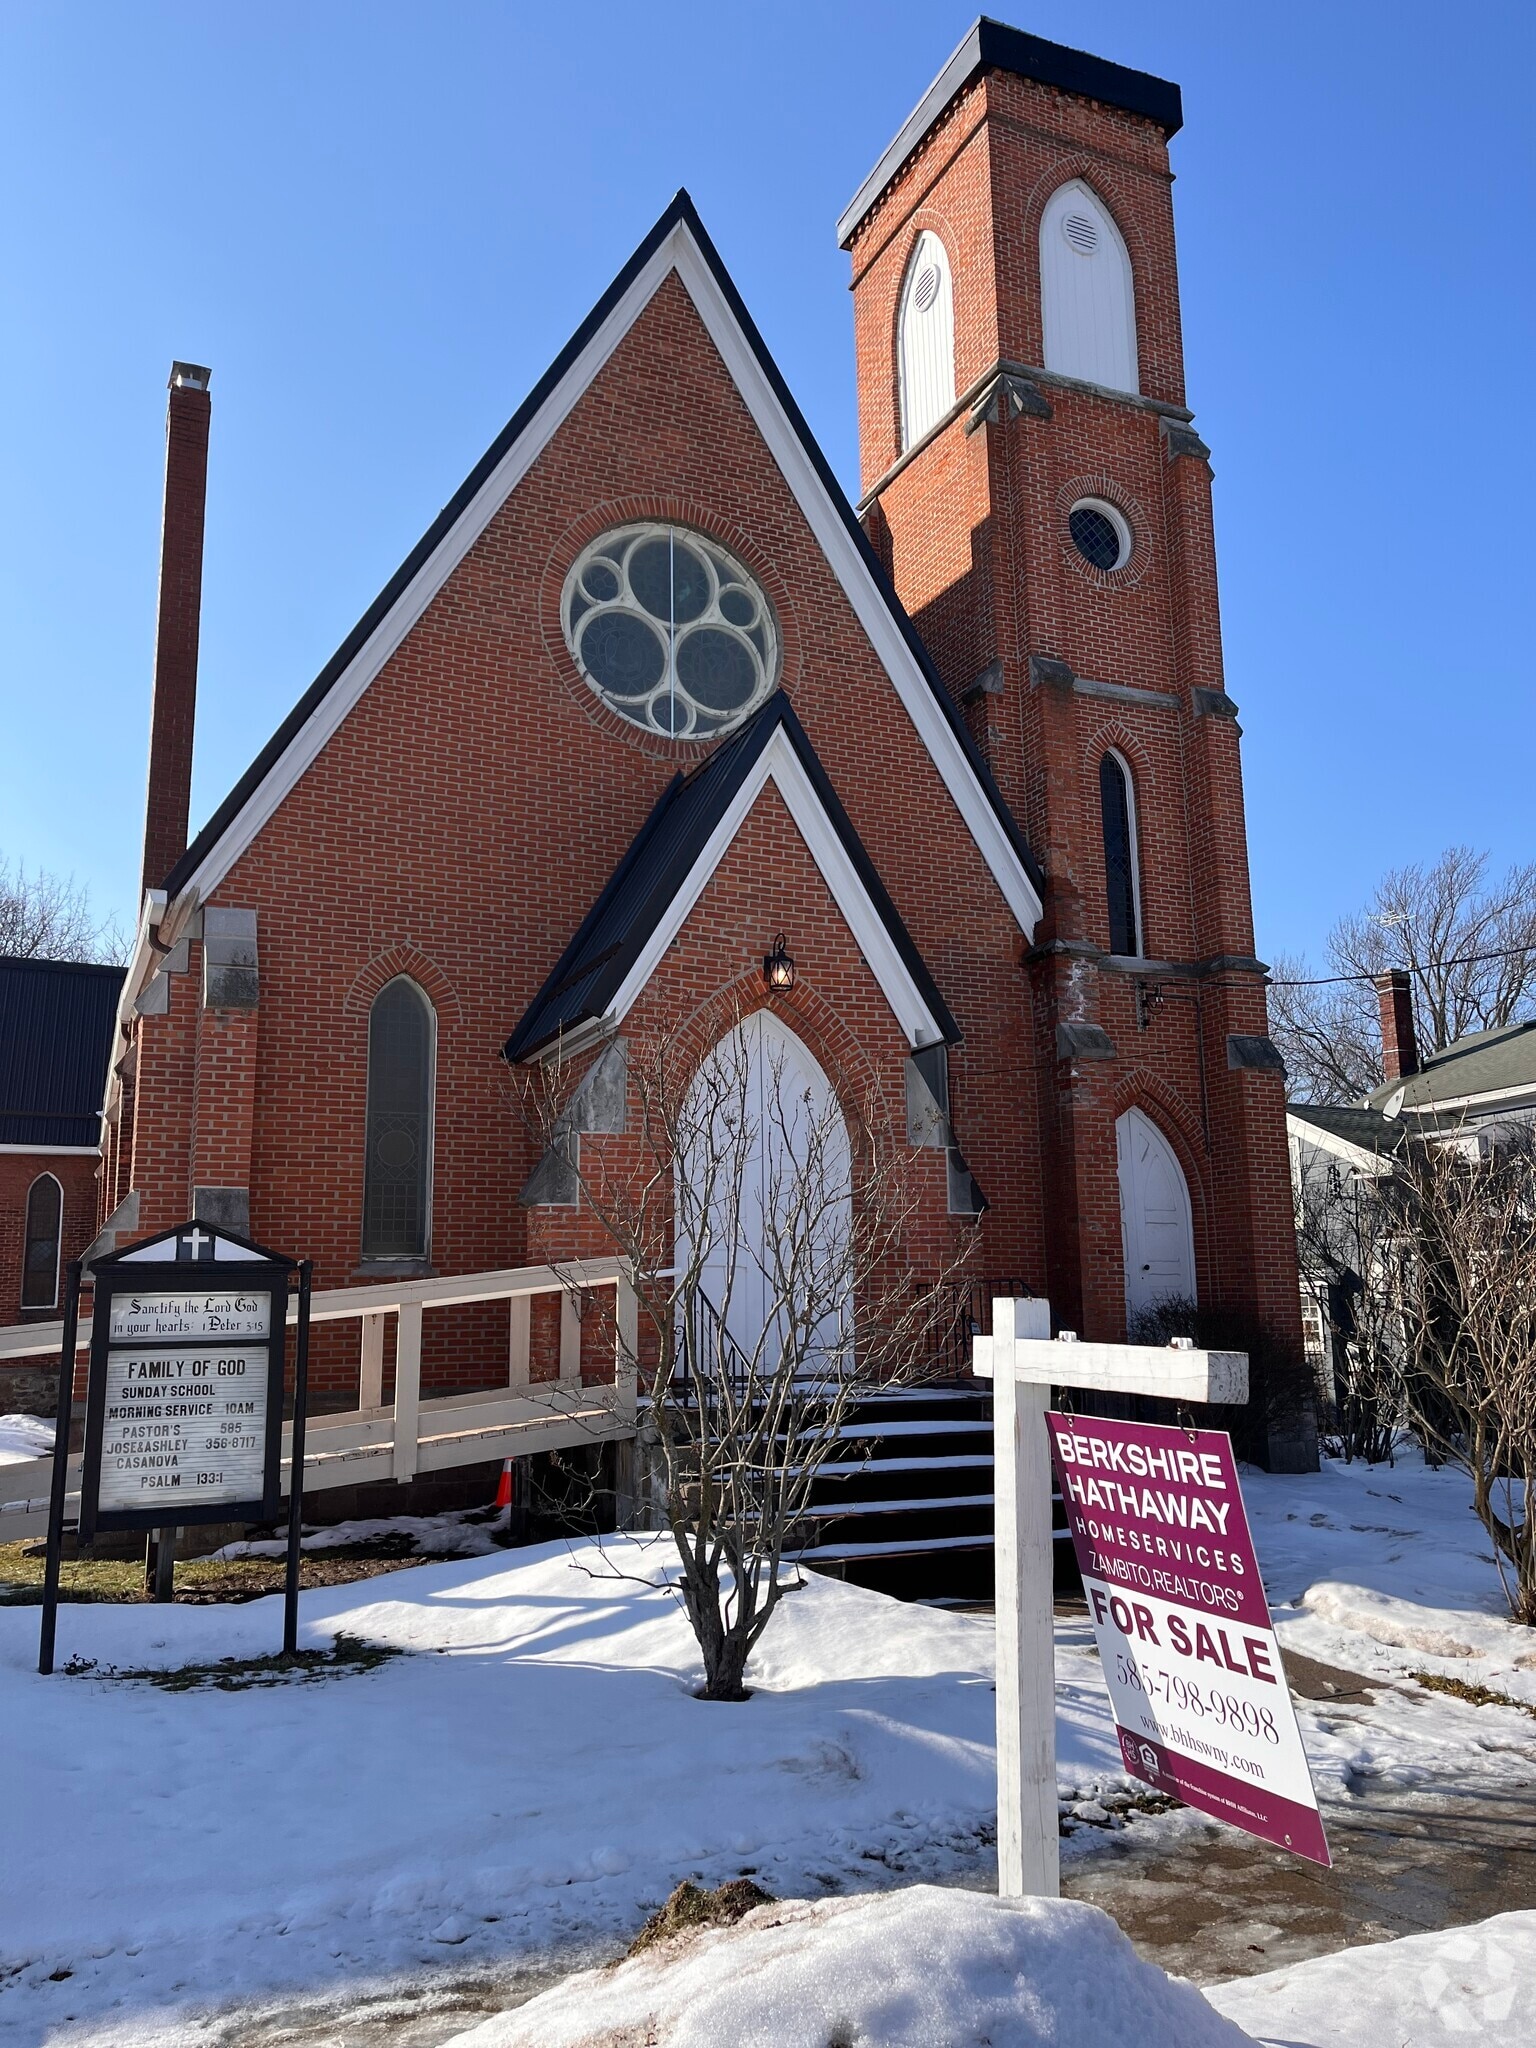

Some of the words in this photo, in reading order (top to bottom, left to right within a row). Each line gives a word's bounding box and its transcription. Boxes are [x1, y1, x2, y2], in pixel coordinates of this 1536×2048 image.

[128, 1298, 180, 1318] Sanctify
[184, 1300, 198, 1314] the
[203, 1298, 230, 1314] Lord
[234, 1297, 258, 1312] God
[114, 1322, 122, 1332] in
[127, 1324, 150, 1336] your
[208, 1316, 241, 1331] Peter
[128, 1361, 184, 1378] FAMILY
[192, 1360, 211, 1376] OF
[218, 1360, 245, 1376] GOD
[122, 1386, 167, 1399] SUNDAY
[170, 1384, 215, 1396] SCHOOL
[108, 1406, 162, 1419] MORNING
[166, 1404, 212, 1416] SERVICE
[226, 1402, 254, 1414] 10AM
[122, 1425, 181, 1438] PASTOR'S
[220, 1423, 242, 1433] 585
[107, 1439, 188, 1454] JOSE&ASHLEY
[206, 1437, 256, 1449] 356-8717
[117, 1455, 178, 1469] CASANOVA
[1055, 1432, 1226, 1490] BERKSHIRE
[141, 1474, 181, 1488] PSALM
[196, 1473, 223, 1484] 133:1
[1066, 1473, 1231, 1535] HATHAWAY
[1075, 1516, 1244, 1575] HOMESERVICES
[1090, 1588, 1161, 1647] FOR
[1167, 1614, 1277, 1685] SALE
[1116, 1654, 1280, 1745] 585-798-9898
[1140, 1715, 1265, 1779] www.bhhswny.com
